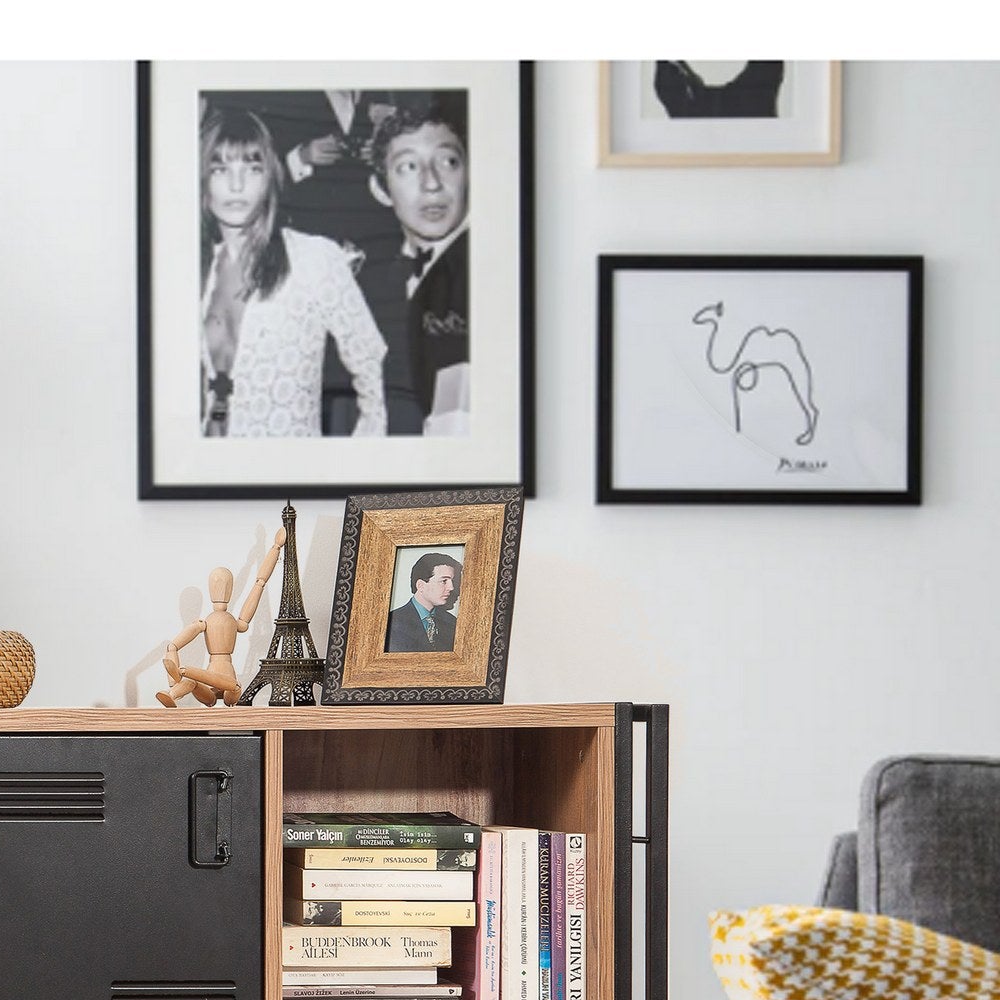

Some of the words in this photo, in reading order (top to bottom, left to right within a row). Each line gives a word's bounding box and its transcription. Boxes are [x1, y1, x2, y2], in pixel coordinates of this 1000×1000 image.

[287, 828, 314, 842] Soner
[316, 829, 343, 844] Yalçın
[383, 856, 428, 864] DOSTOYEVSKİ
[576, 858, 584, 910] DAWKINS
[557, 914, 562, 922] ve
[301, 936, 392, 948] BUDDENBROOK
[401, 937, 438, 947] Thomas
[569, 914, 582, 982] YANILGISI
[301, 946, 338, 959] AİLESİ
[404, 947, 433, 958] Mann
